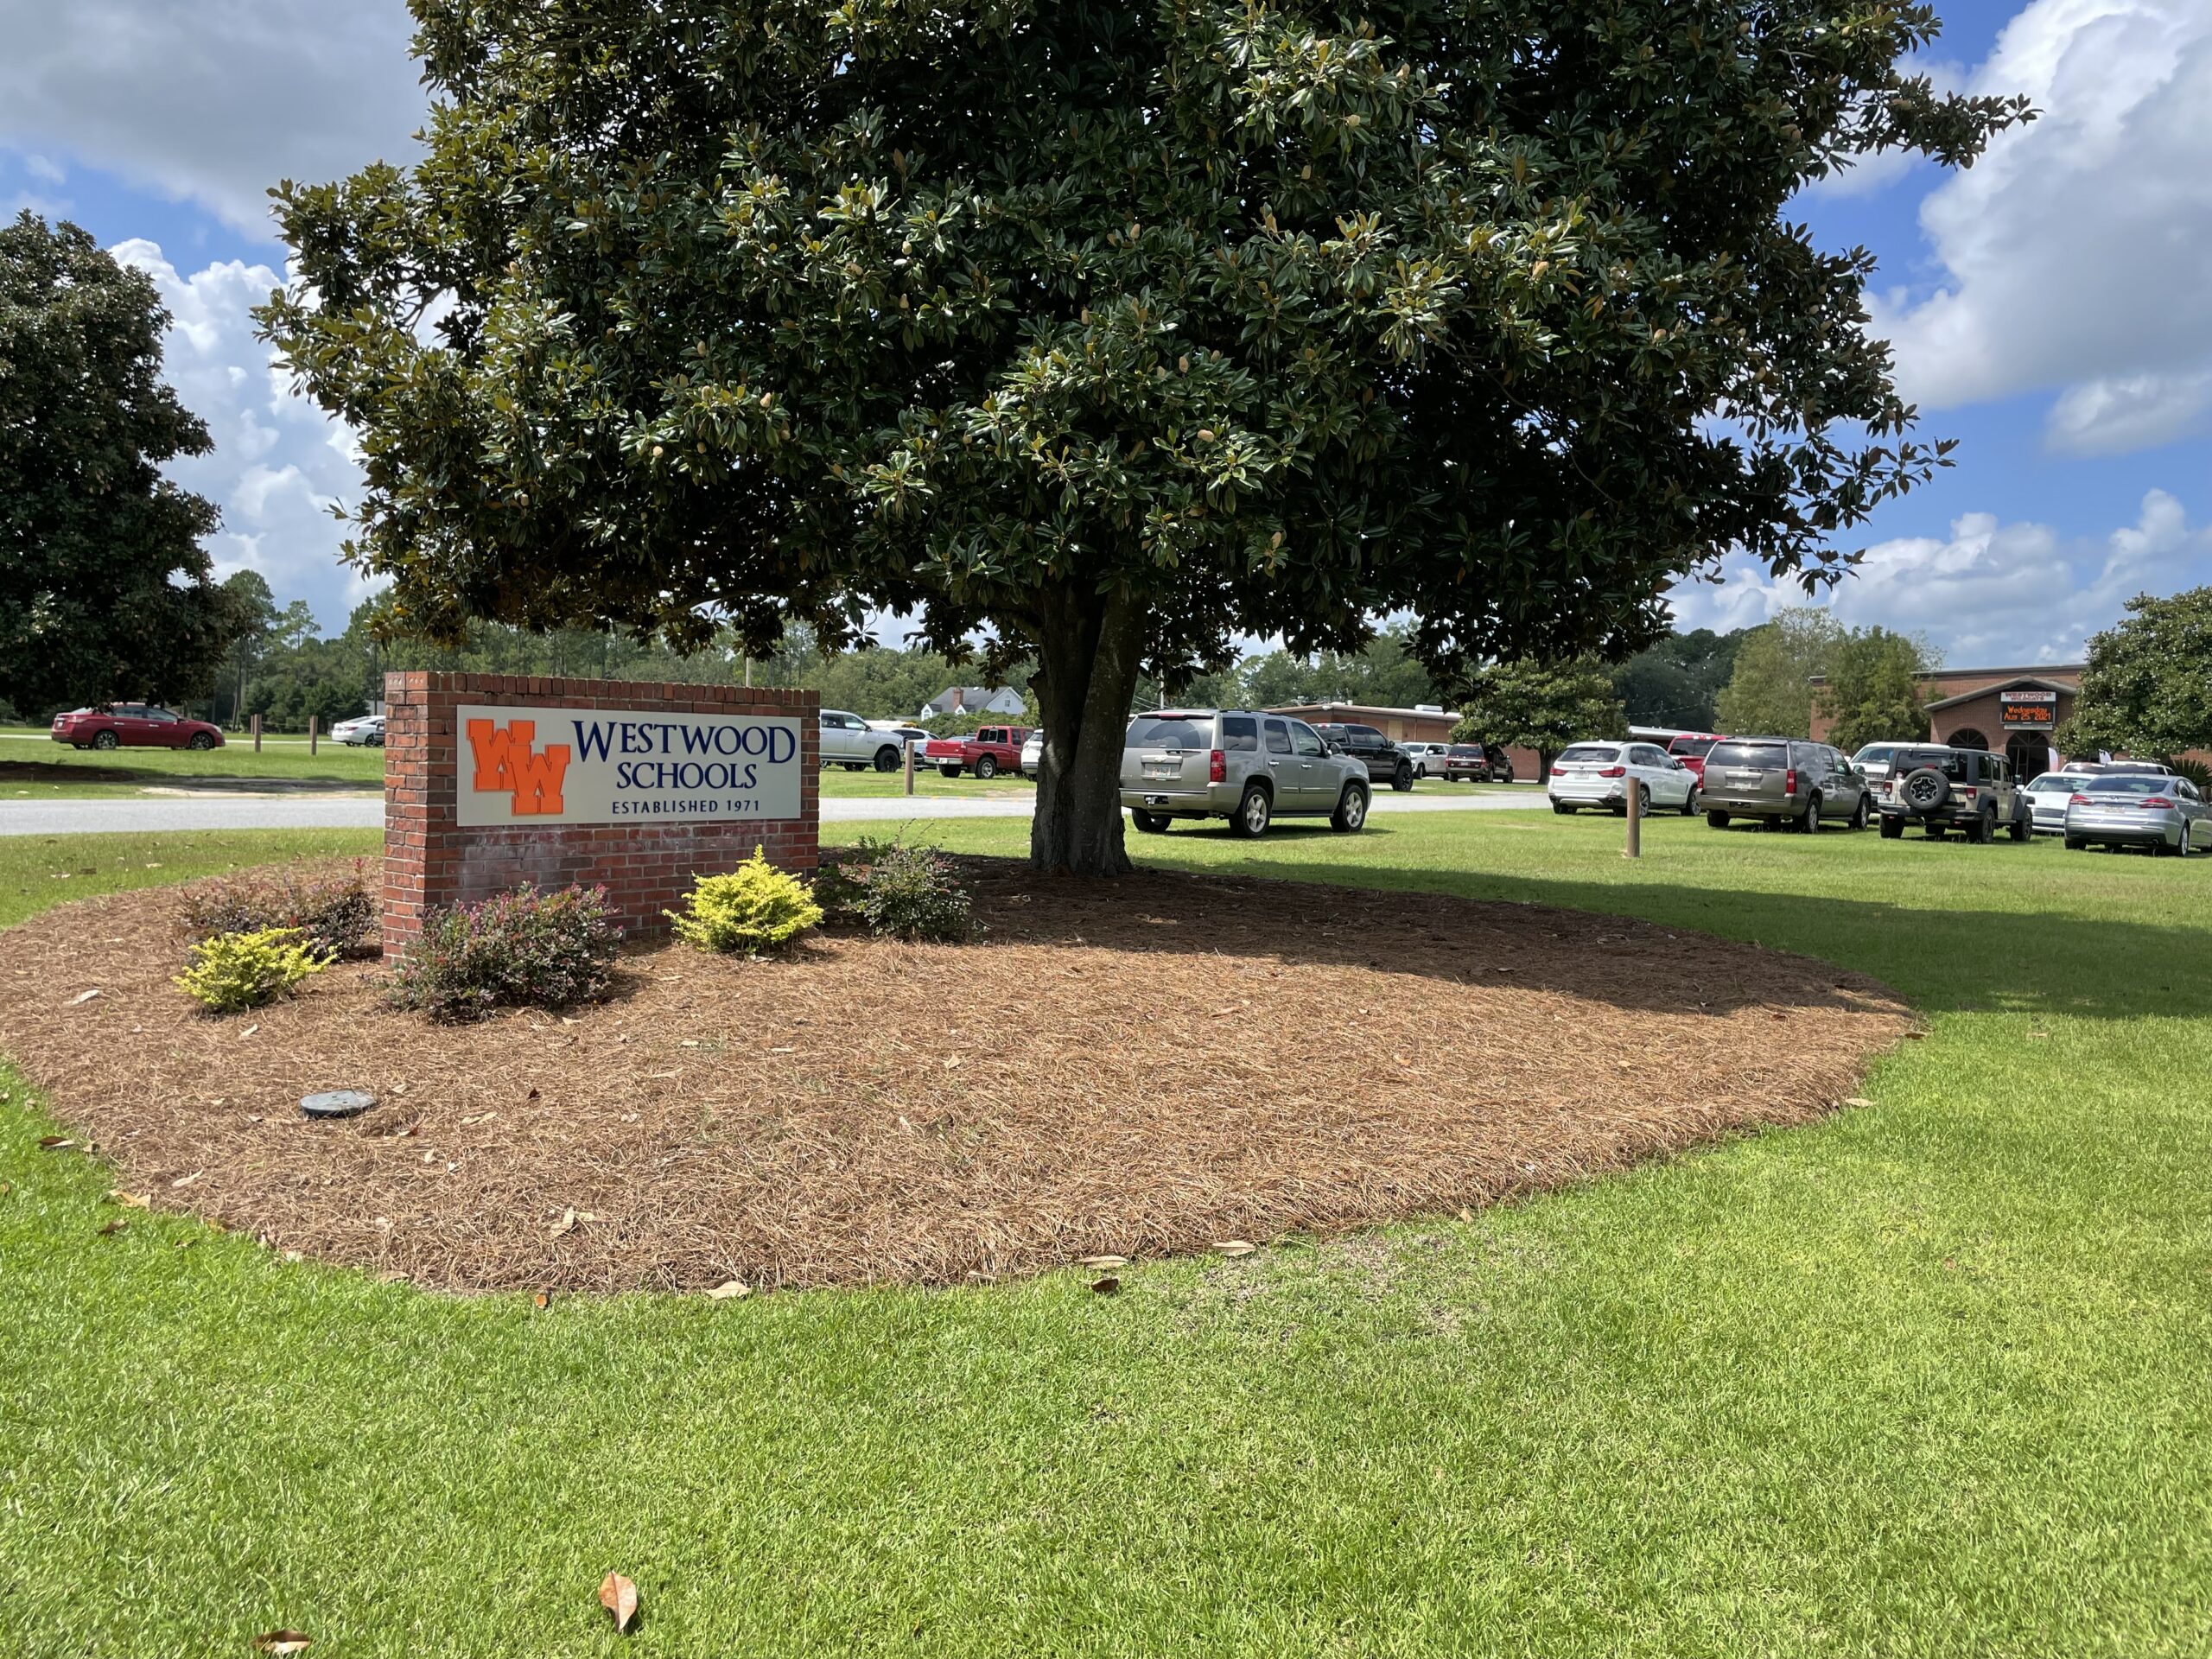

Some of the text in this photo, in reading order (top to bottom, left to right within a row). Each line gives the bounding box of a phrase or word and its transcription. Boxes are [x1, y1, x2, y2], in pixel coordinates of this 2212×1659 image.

[2007, 705, 2048, 715] Wednesday
[572, 720, 796, 764] WESTWOOD
[616, 762, 757, 789] SCHOOLS
[613, 800, 760, 814] ESTABLISHED 1971
